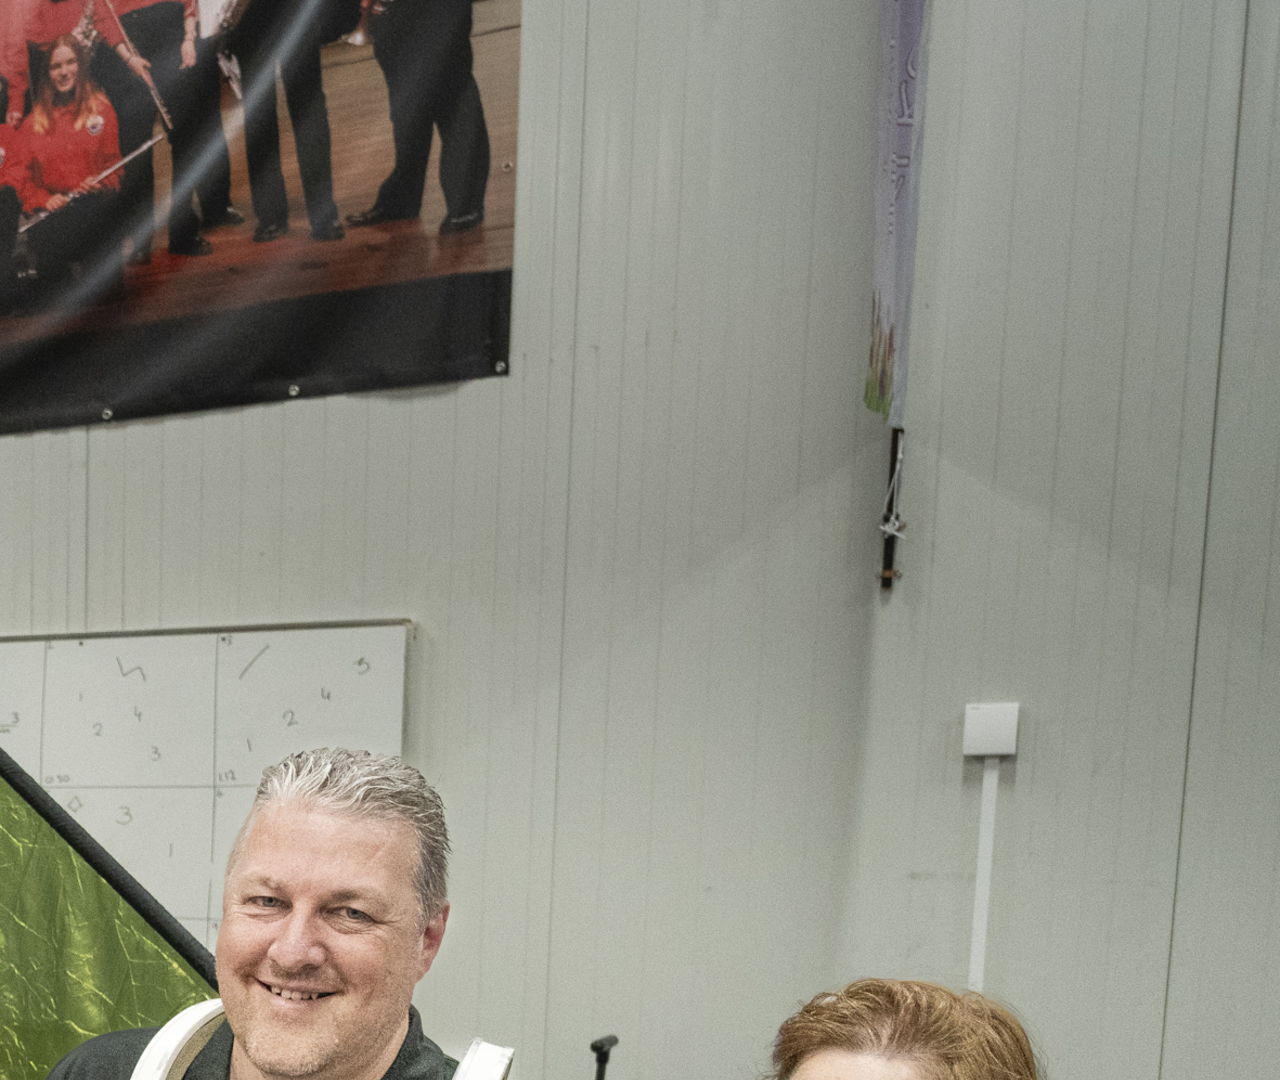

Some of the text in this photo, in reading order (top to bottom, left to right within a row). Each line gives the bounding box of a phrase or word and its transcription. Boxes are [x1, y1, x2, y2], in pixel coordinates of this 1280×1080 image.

[282, 709, 298, 727] 2
[92, 721, 104, 737] 2
[151, 745, 161, 762] 3
[114, 805, 134, 826] 3
